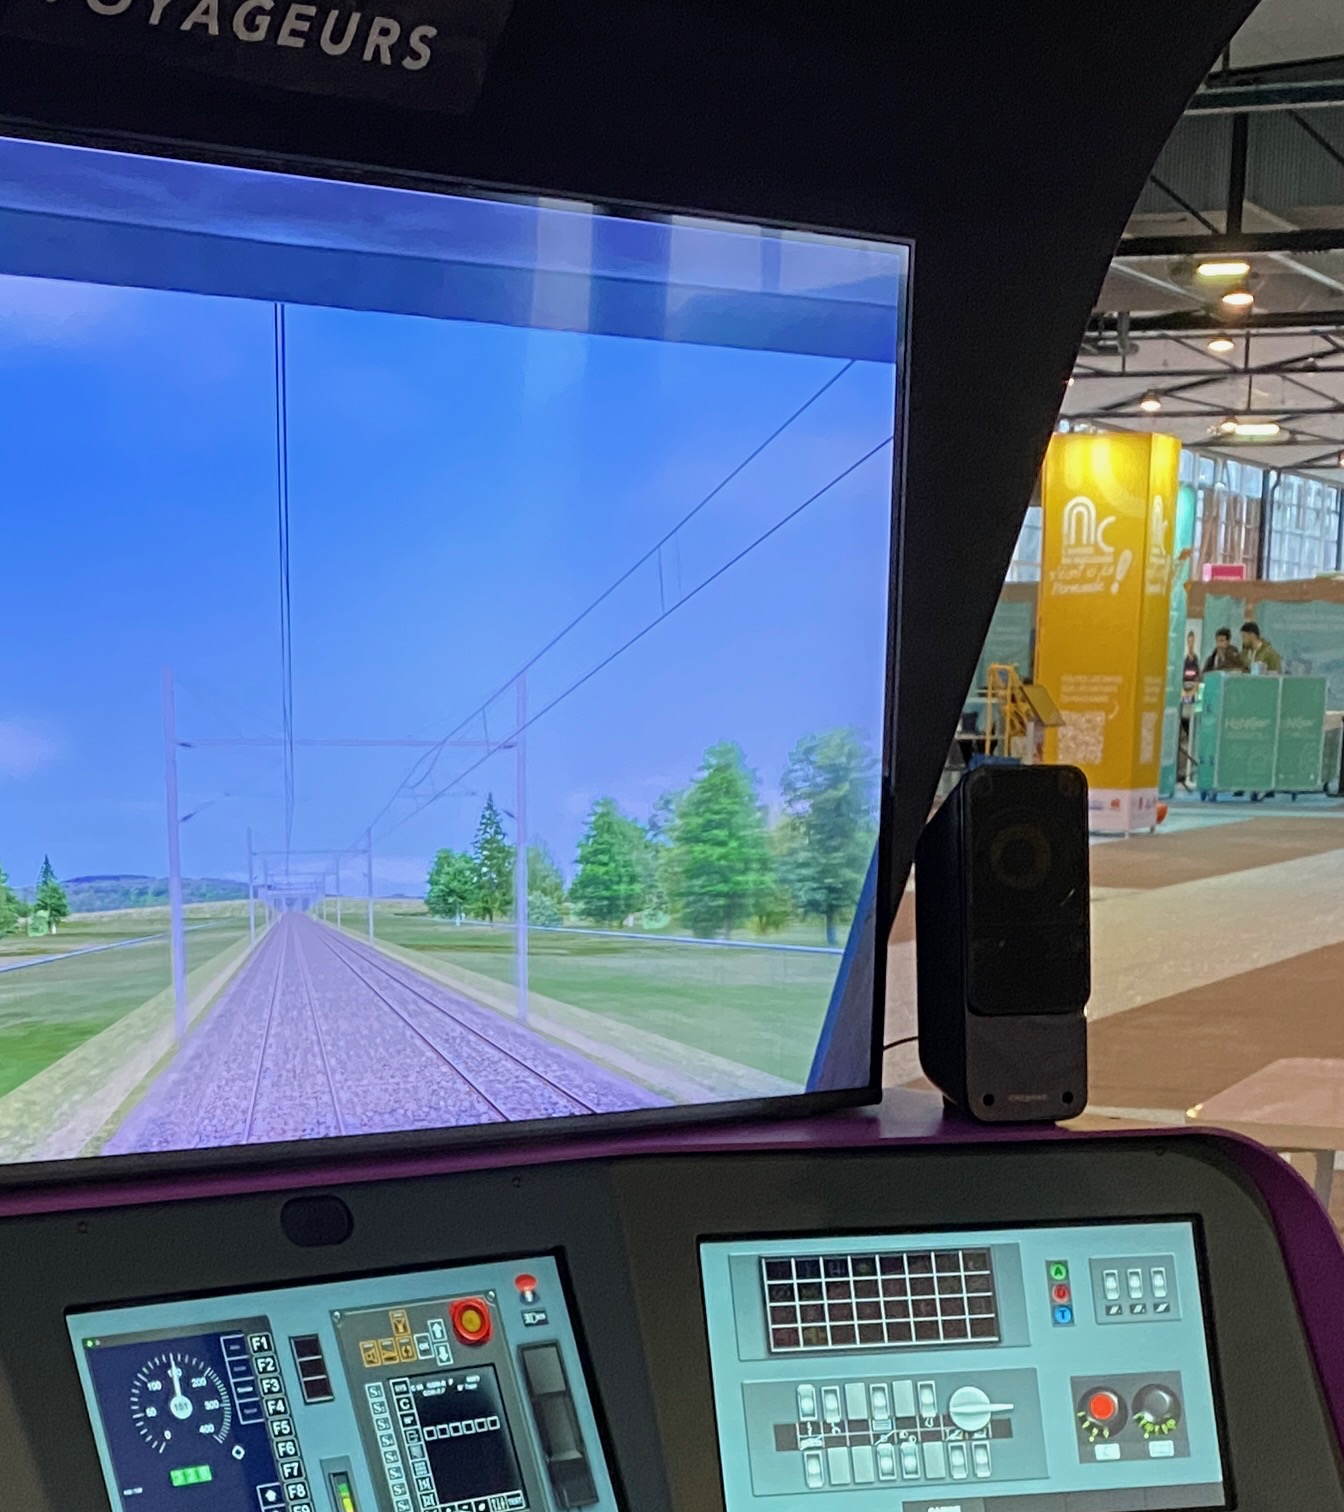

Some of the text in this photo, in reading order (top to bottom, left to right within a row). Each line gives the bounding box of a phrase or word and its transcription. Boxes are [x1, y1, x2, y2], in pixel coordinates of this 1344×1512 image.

[252, 1335, 268, 1350] F1
[257, 1358, 275, 1371] F2
[262, 1379, 280, 1393] F3
[267, 1400, 285, 1414] F4
[164, 1430, 171, 1440] 0
[272, 1421, 291, 1435] F5
[277, 1441, 295, 1455] F6
[282, 1463, 299, 1477] F7
[288, 1483, 306, 1498] F8
